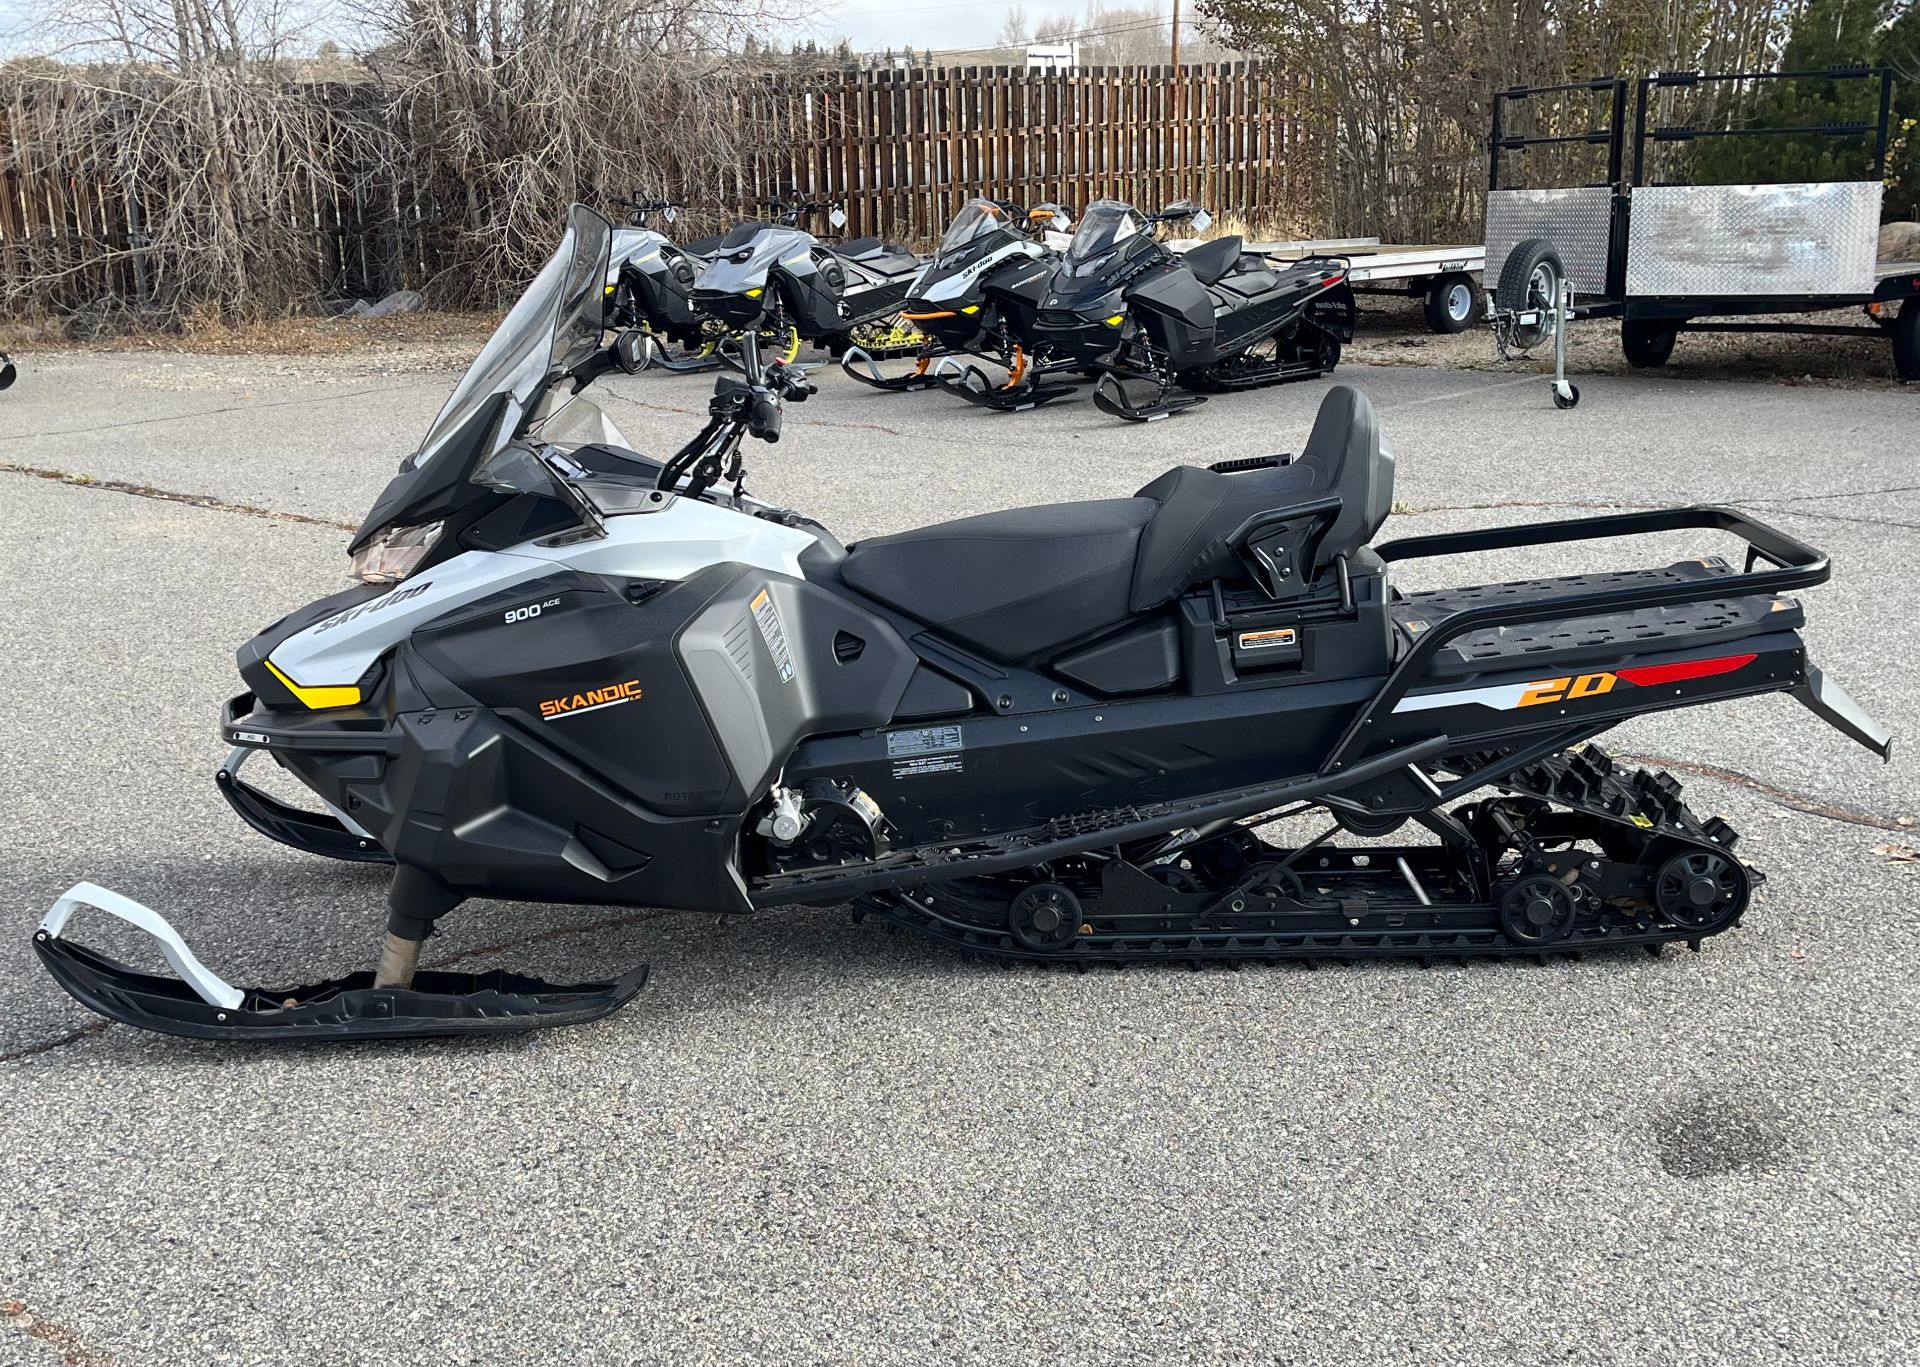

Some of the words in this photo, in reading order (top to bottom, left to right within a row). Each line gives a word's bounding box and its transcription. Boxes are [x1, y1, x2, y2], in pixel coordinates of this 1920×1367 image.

[1442, 260, 1467, 270] TRITON
[504, 604, 542, 624] 900
[542, 597, 561, 609] ACE
[539, 679, 642, 716] SKANDIC
[1517, 672, 1618, 708] 20
